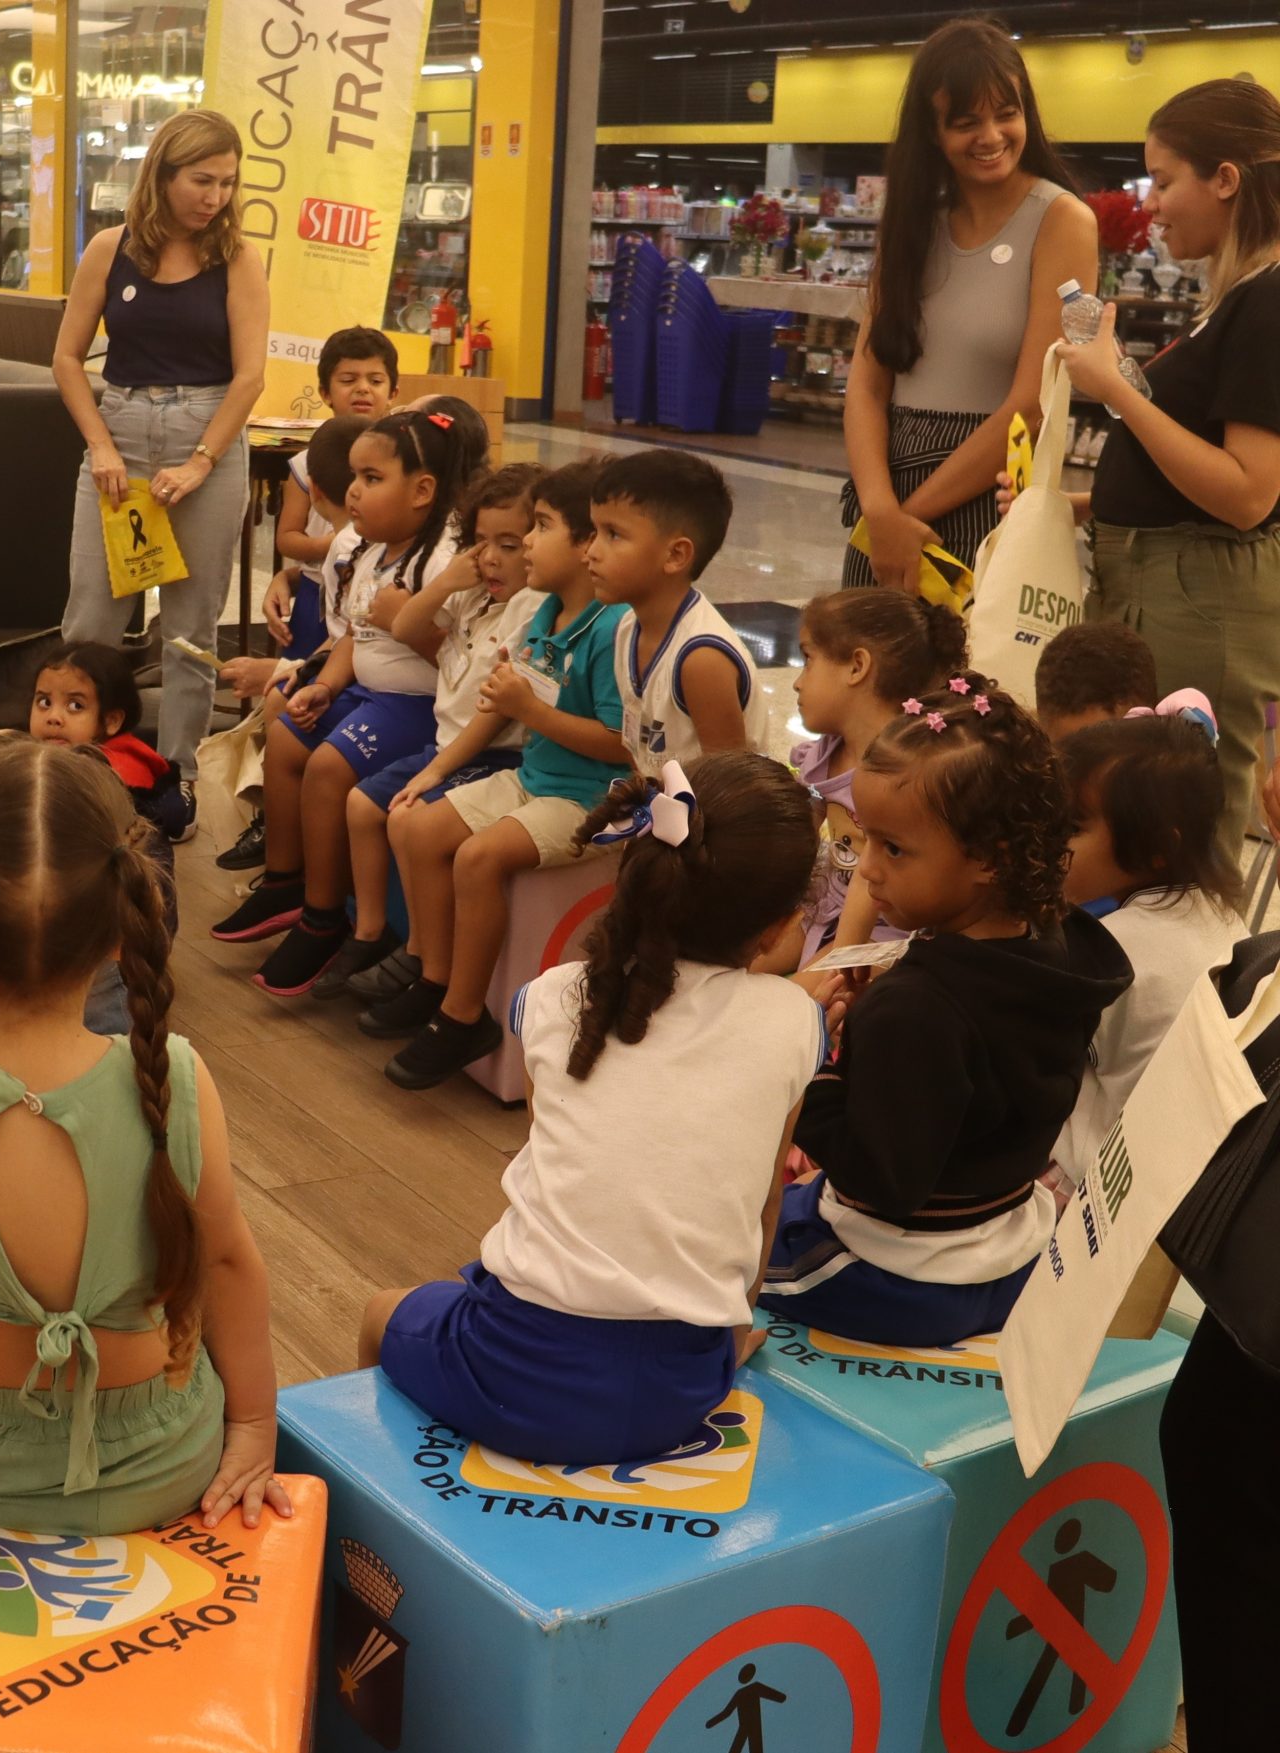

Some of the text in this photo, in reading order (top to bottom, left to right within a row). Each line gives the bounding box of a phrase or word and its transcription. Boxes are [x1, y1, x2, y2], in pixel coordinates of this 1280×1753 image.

[286, 342, 321, 362] aqu
[1014, 631, 1041, 646] CNT
[1082, 1202, 1099, 1260] SENAT
[777, 1341, 825, 1366] DE
[830, 1358, 1004, 1392] TRÂNSIT
[420, 1472, 472, 1502] DE
[477, 1494, 720, 1538] TRÂNSITO
[222, 1572, 261, 1604] DE
